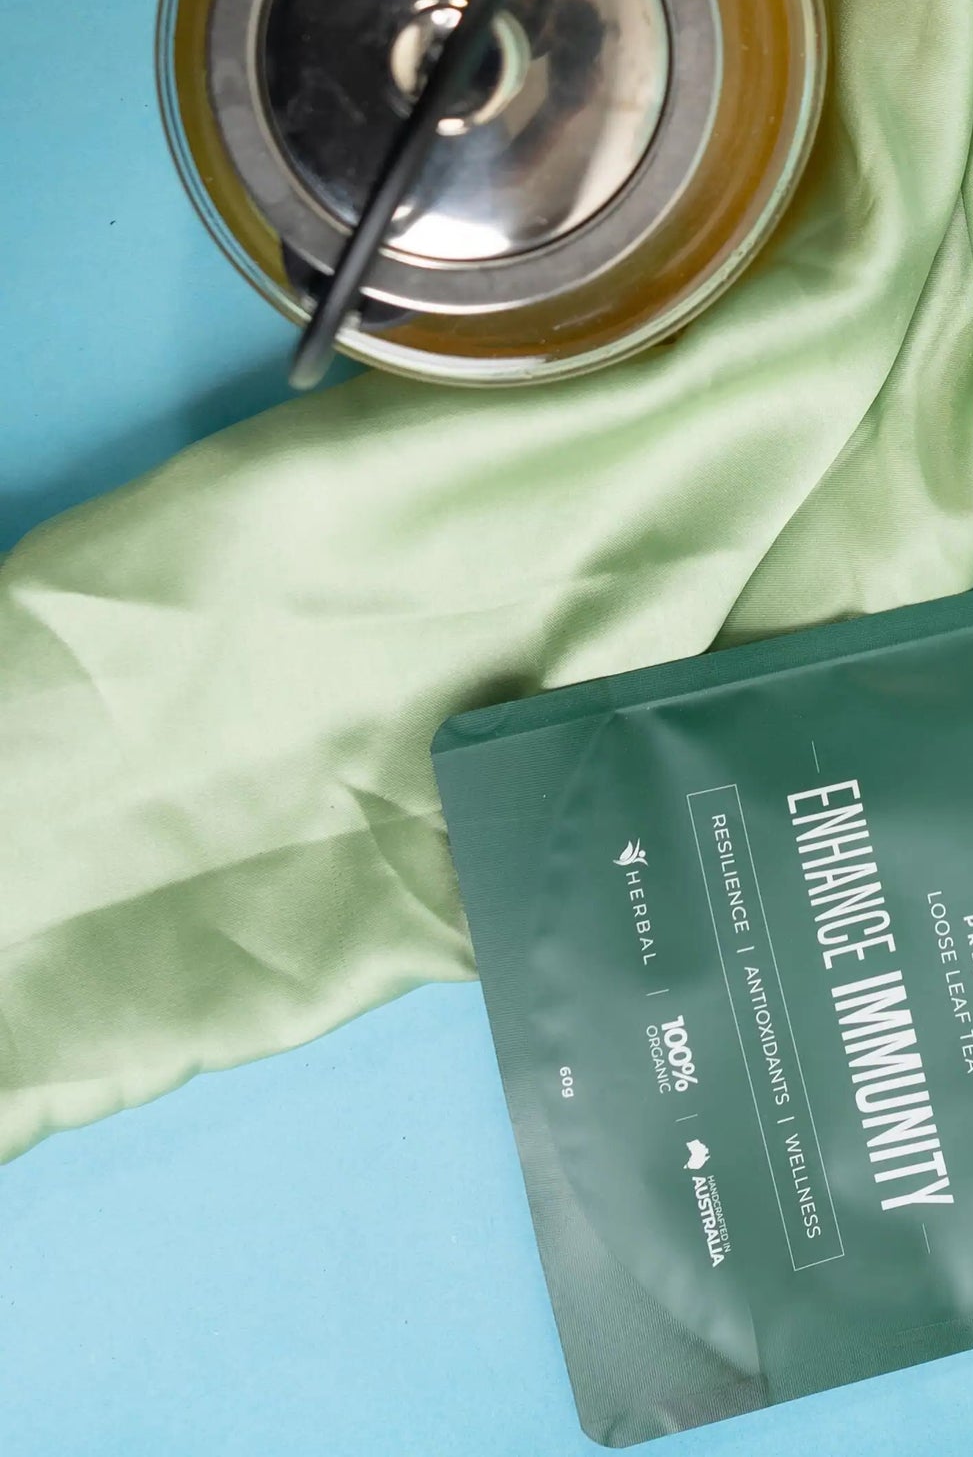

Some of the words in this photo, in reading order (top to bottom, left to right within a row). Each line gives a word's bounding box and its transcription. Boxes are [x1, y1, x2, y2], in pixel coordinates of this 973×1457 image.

[626, 870, 657, 966] HERBAL
[787, 779, 896, 969] ENHANCE
[927, 891, 958, 964] LOOSE
[945, 970, 972, 1024] LEAF
[646, 1025, 671, 1094] ORGANIC
[661, 1015, 698, 1092] 100%
[712, 814, 750, 934] RESILIENCE
[744, 966, 790, 1105] ANTIOXIDANTS
[785, 1133, 821, 1239] WELLNESS
[559, 1066, 574, 1099] 60g
[831, 970, 955, 1211] IMMUNITY
[692, 1176, 725, 1268] AUSTRALIA
[707, 1174, 729, 1241] HANDCRAFTED
[723, 1242, 732, 1253] IN
